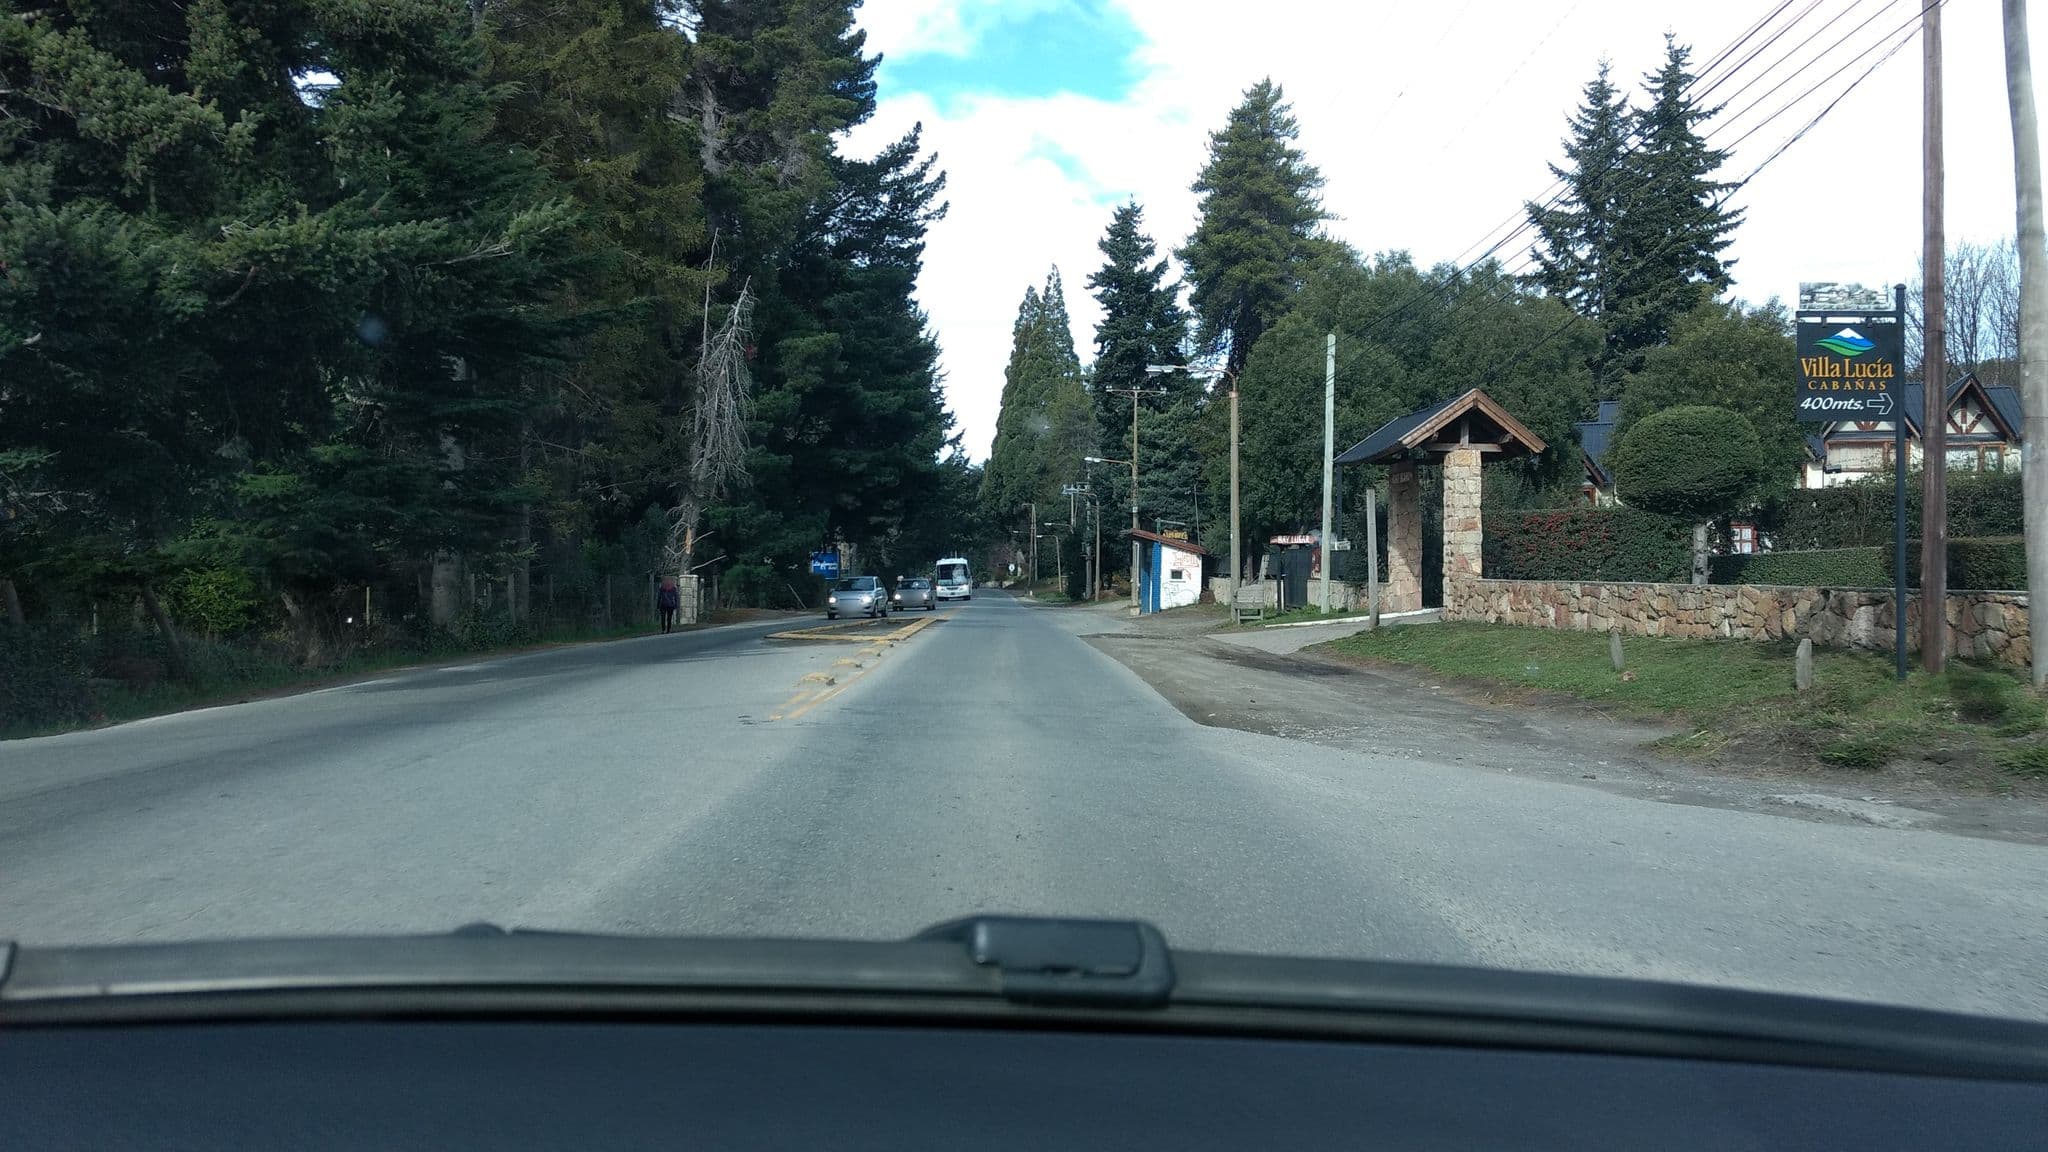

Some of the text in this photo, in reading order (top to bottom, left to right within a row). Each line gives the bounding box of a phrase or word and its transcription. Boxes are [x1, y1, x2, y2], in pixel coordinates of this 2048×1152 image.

[1801, 357, 1894, 377] Villa Lucía
[1808, 378, 1886, 390] CABAÑAS
[1800, 397, 1865, 410] 400mts.
